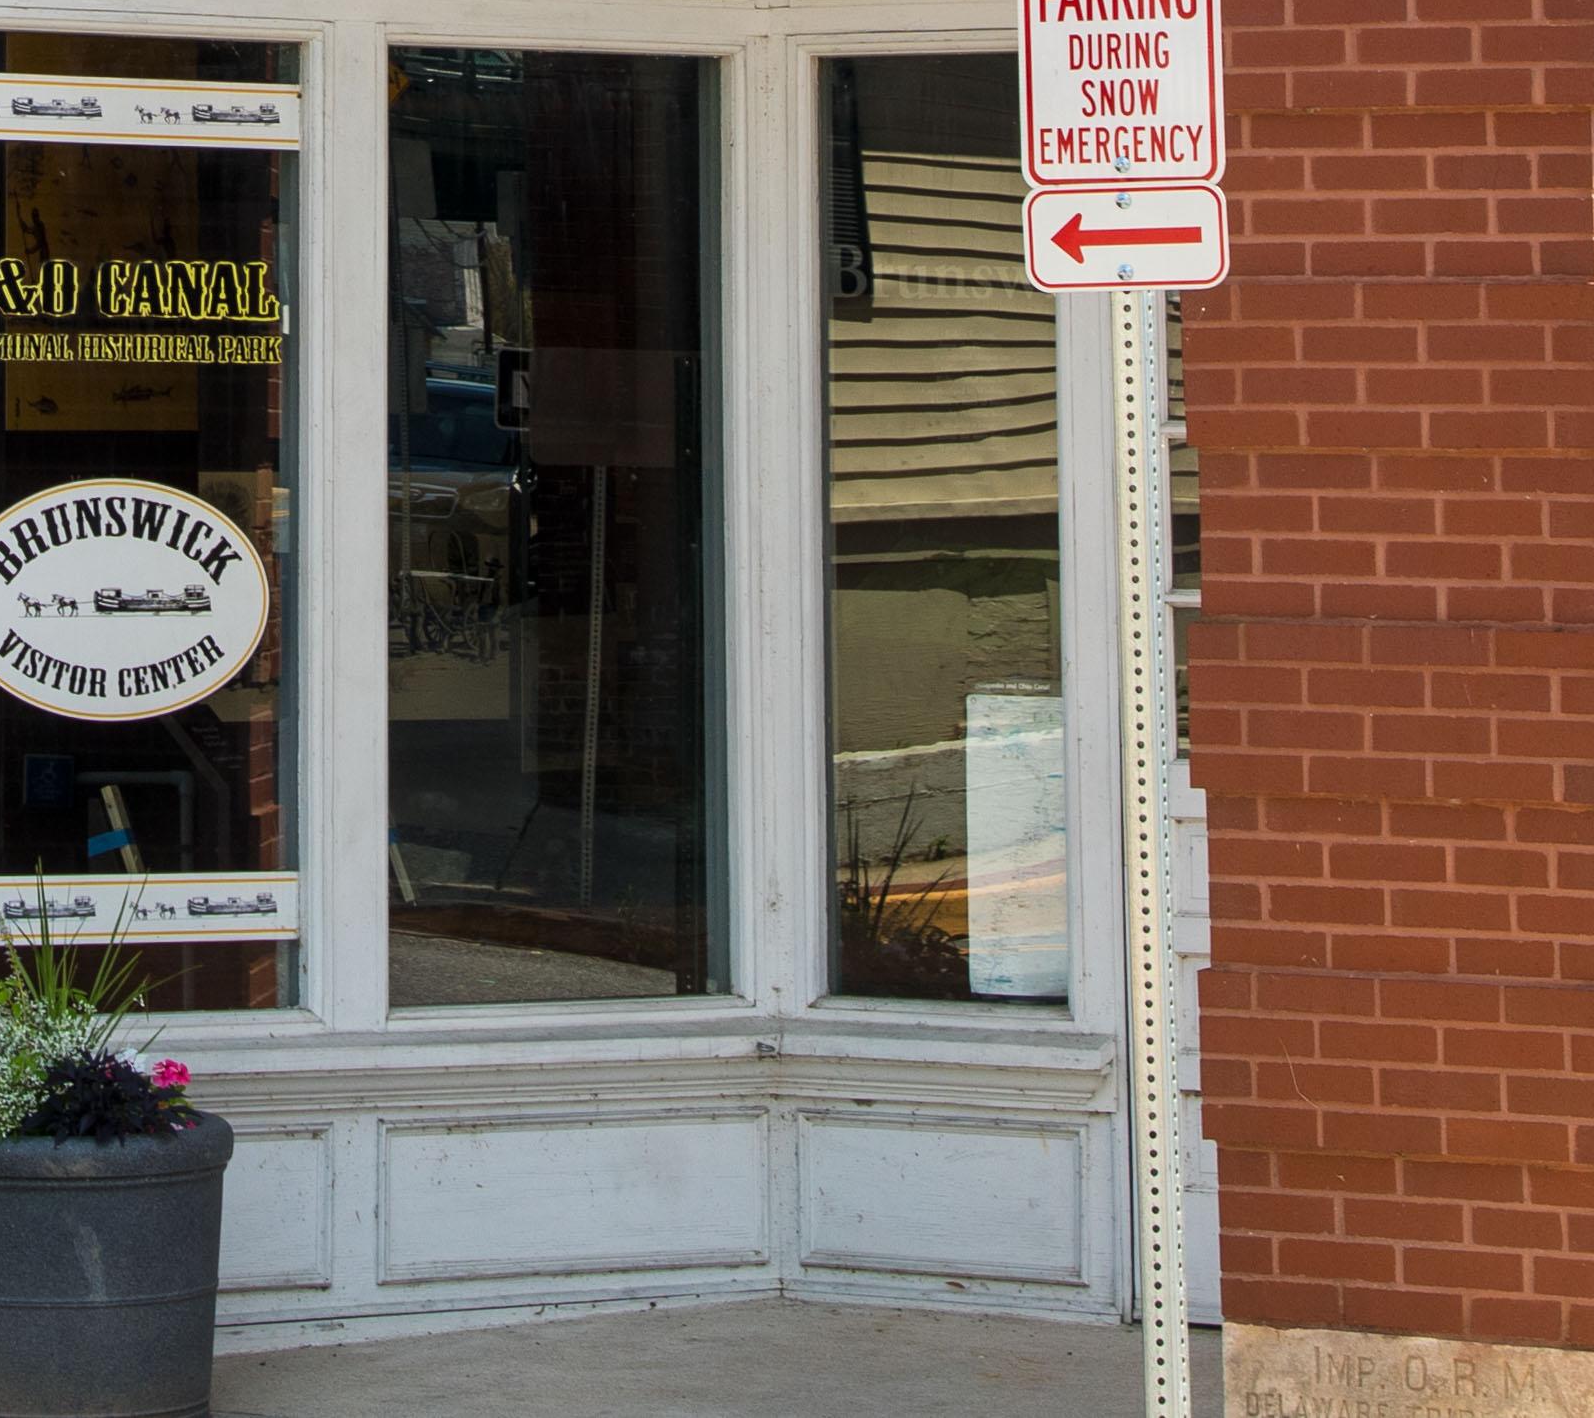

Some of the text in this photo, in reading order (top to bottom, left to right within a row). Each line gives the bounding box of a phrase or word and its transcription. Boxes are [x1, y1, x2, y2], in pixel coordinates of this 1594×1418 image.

[1069, 31, 1170, 70] DURING
[1081, 78, 1159, 117] SNOW
[1039, 125, 1203, 164] EMERGENCY
[98, 260, 280, 322] CANAL
[78, 333, 214, 363] HISTORICAL
[218, 335, 282, 364] PARK
[118, 634, 225, 697] CENTER
